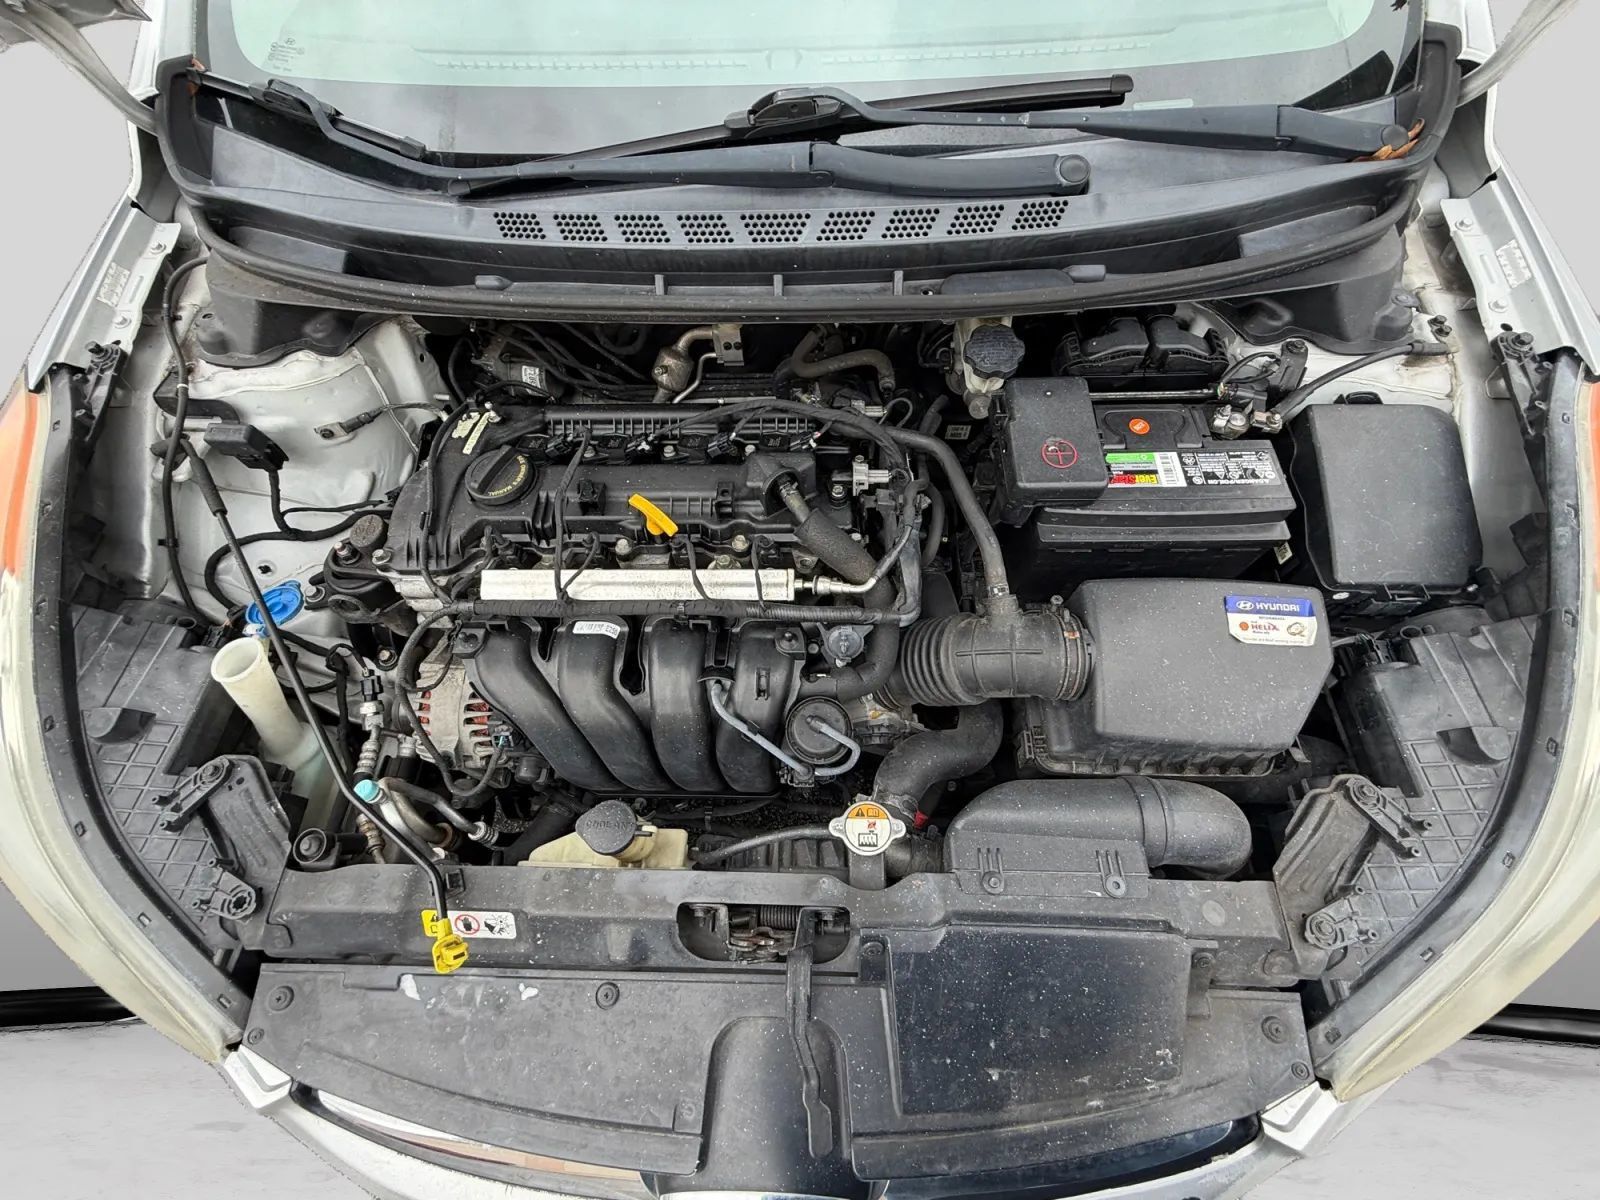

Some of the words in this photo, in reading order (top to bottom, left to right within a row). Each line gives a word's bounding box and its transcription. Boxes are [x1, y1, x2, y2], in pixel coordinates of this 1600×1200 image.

[487, 485, 513, 497] MANUAL
[1255, 602, 1300, 612] HYUNDAI
[1250, 622, 1280, 631] HELIX
